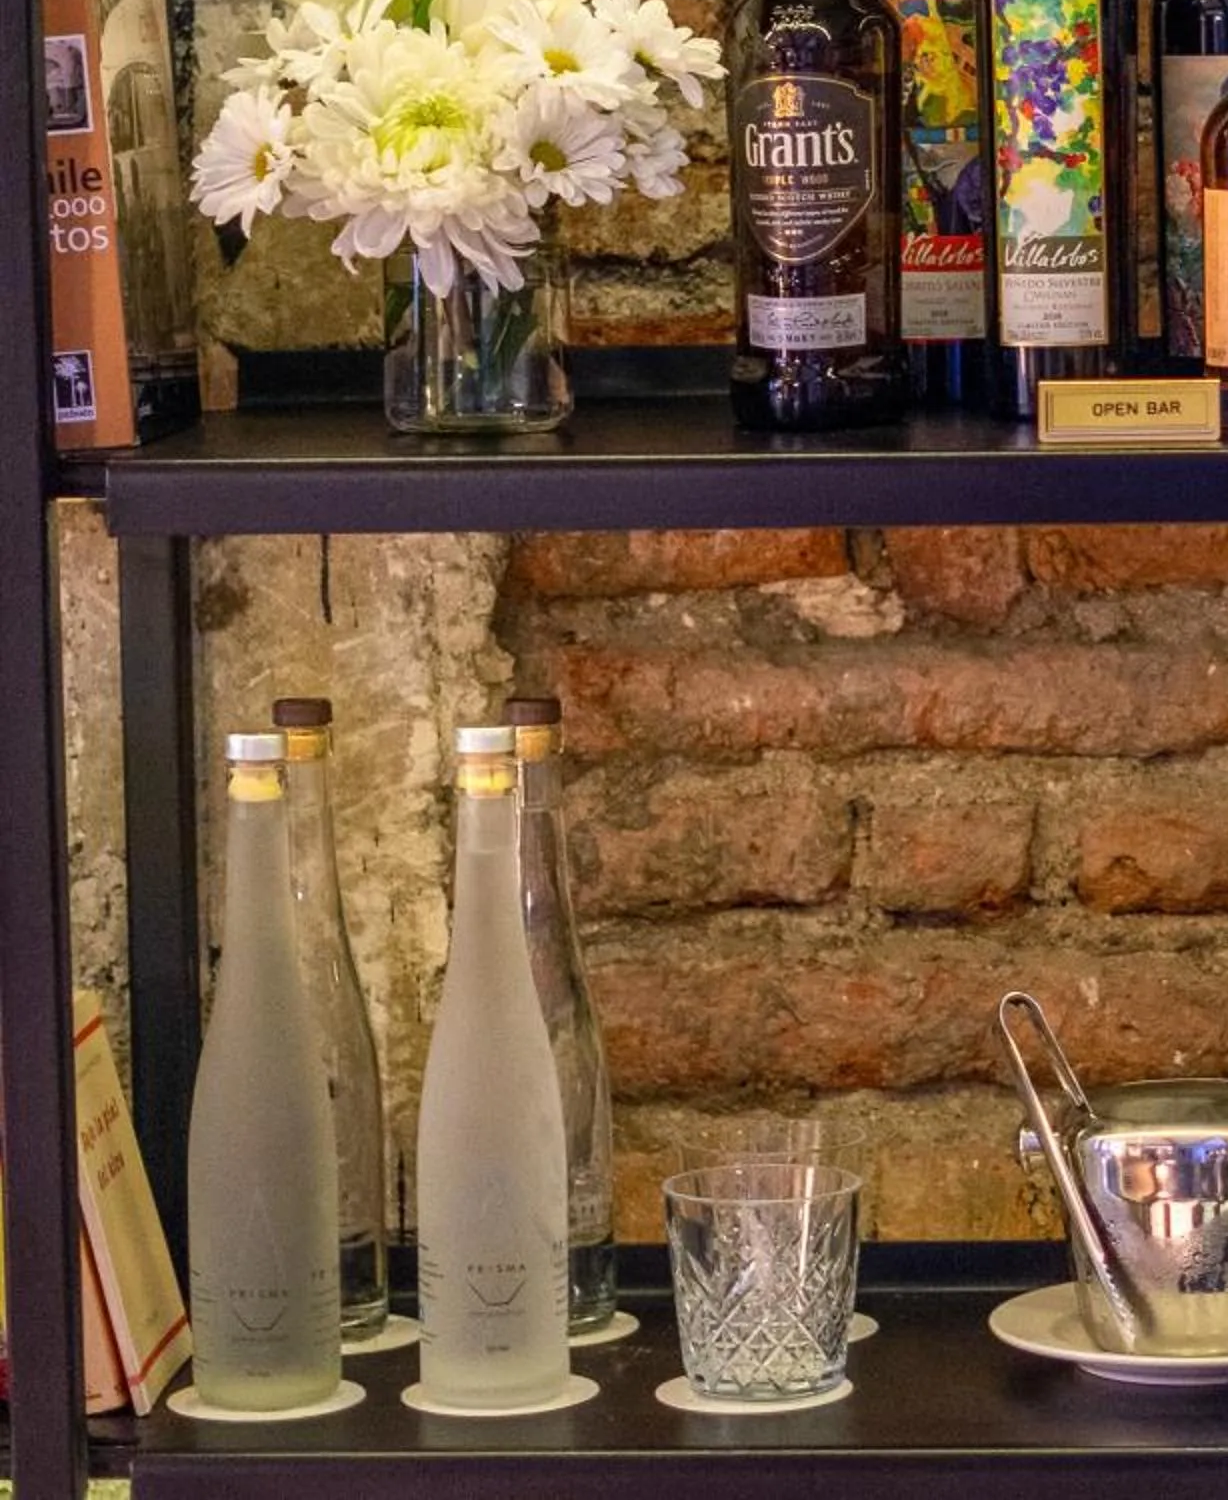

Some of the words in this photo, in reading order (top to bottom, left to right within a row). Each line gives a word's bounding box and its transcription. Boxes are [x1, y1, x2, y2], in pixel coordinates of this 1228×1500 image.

[745, 122, 855, 167] Grant's
[1005, 231, 1099, 268] Villalobos
[1091, 402, 1139, 418] OPEN
[1146, 400, 1181, 416] BAR
